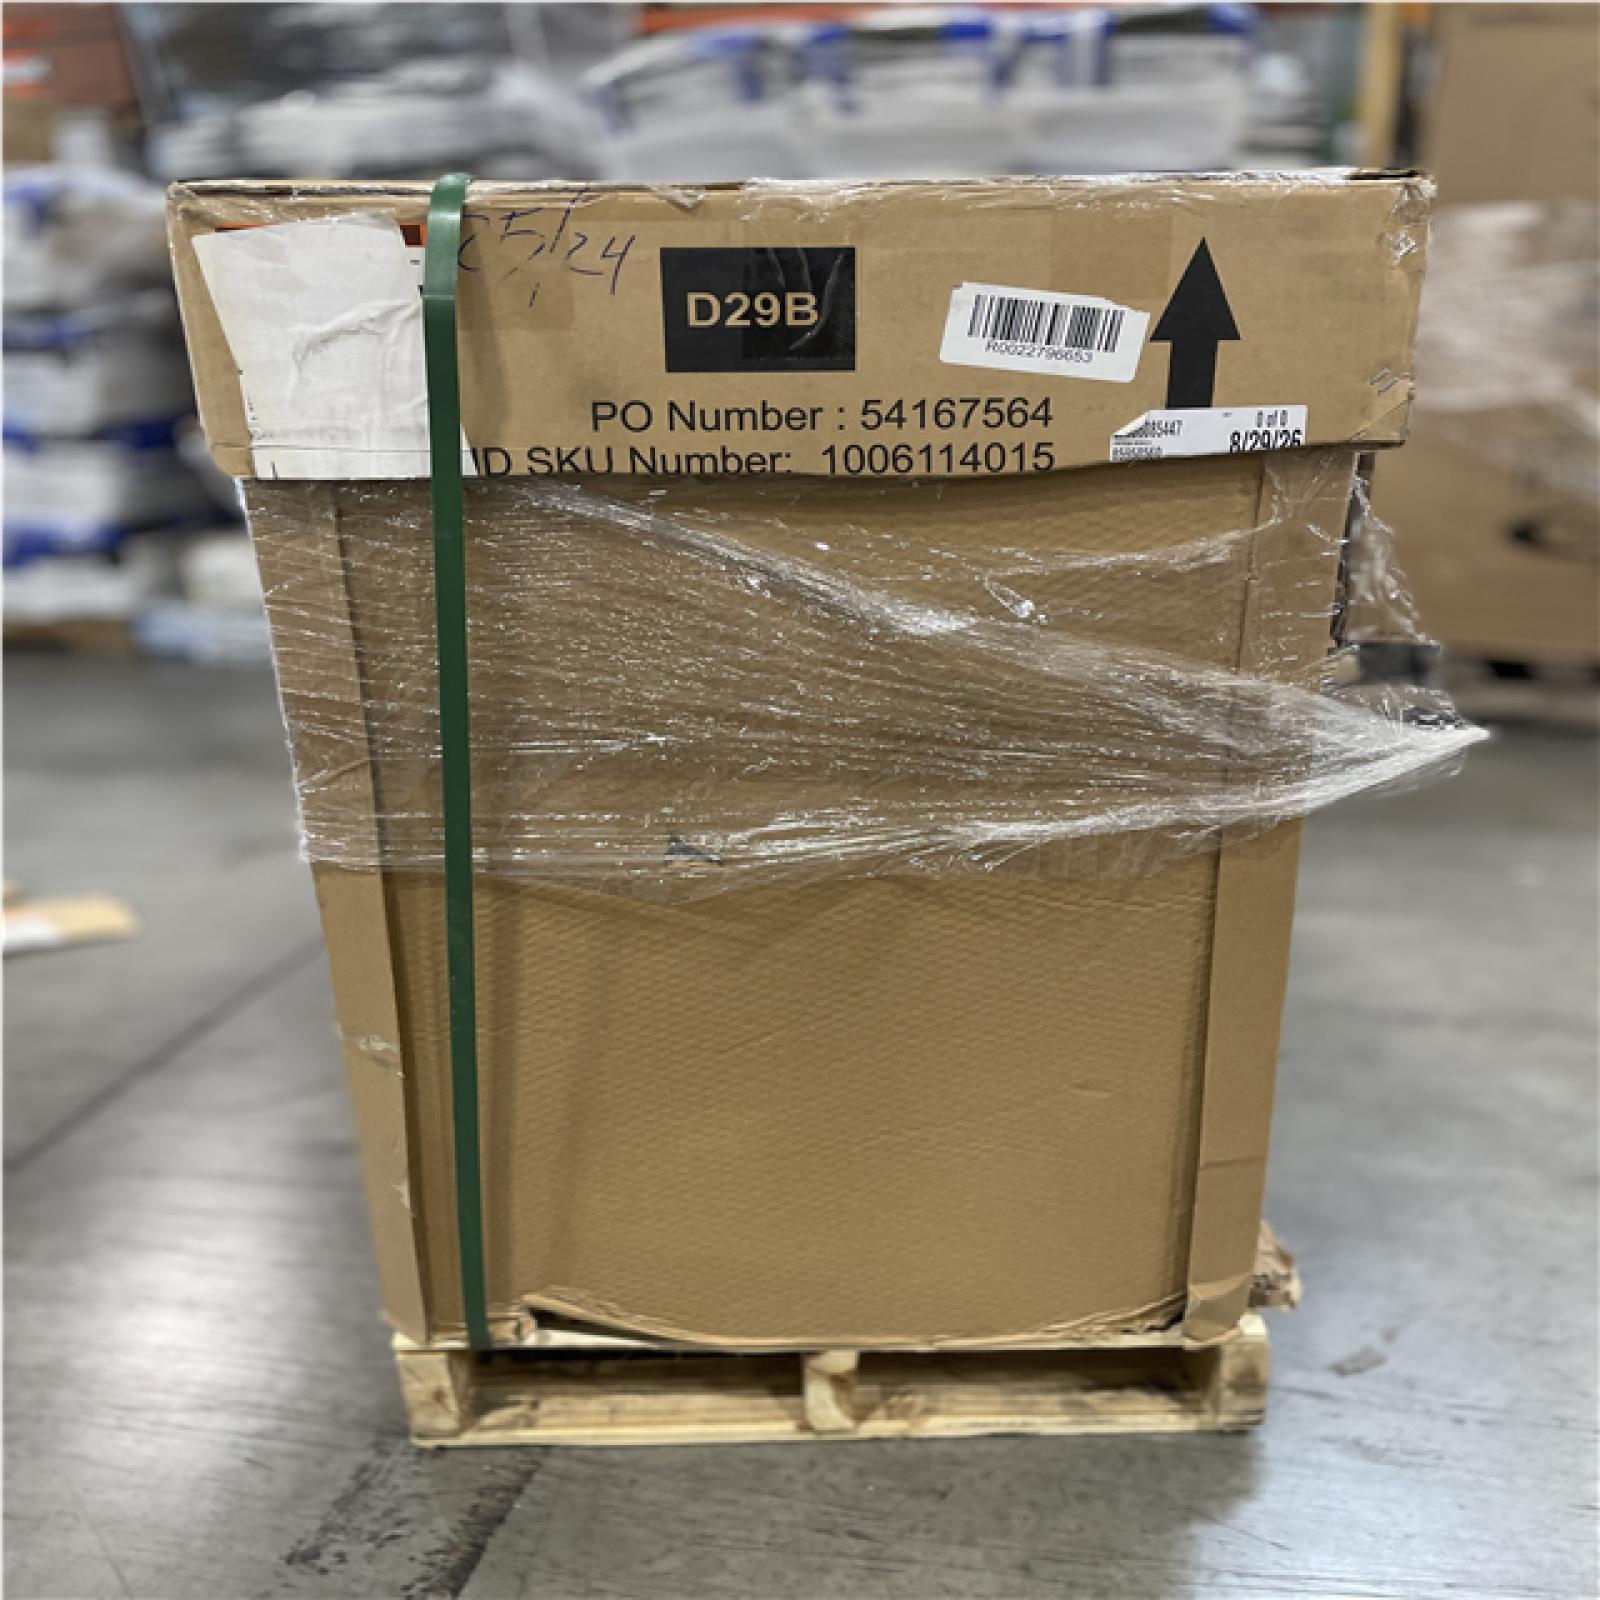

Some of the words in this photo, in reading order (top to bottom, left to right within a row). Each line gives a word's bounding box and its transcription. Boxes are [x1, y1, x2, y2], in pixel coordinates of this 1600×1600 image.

[686, 291, 819, 327] D29B
[592, 400, 652, 433] PO
[668, 400, 823, 432] Number
[860, 397, 1053, 429] 54167564
[527, 446, 613, 474] SKU
[631, 445, 791, 474] Number:
[822, 442, 1055, 475] 1006114015
